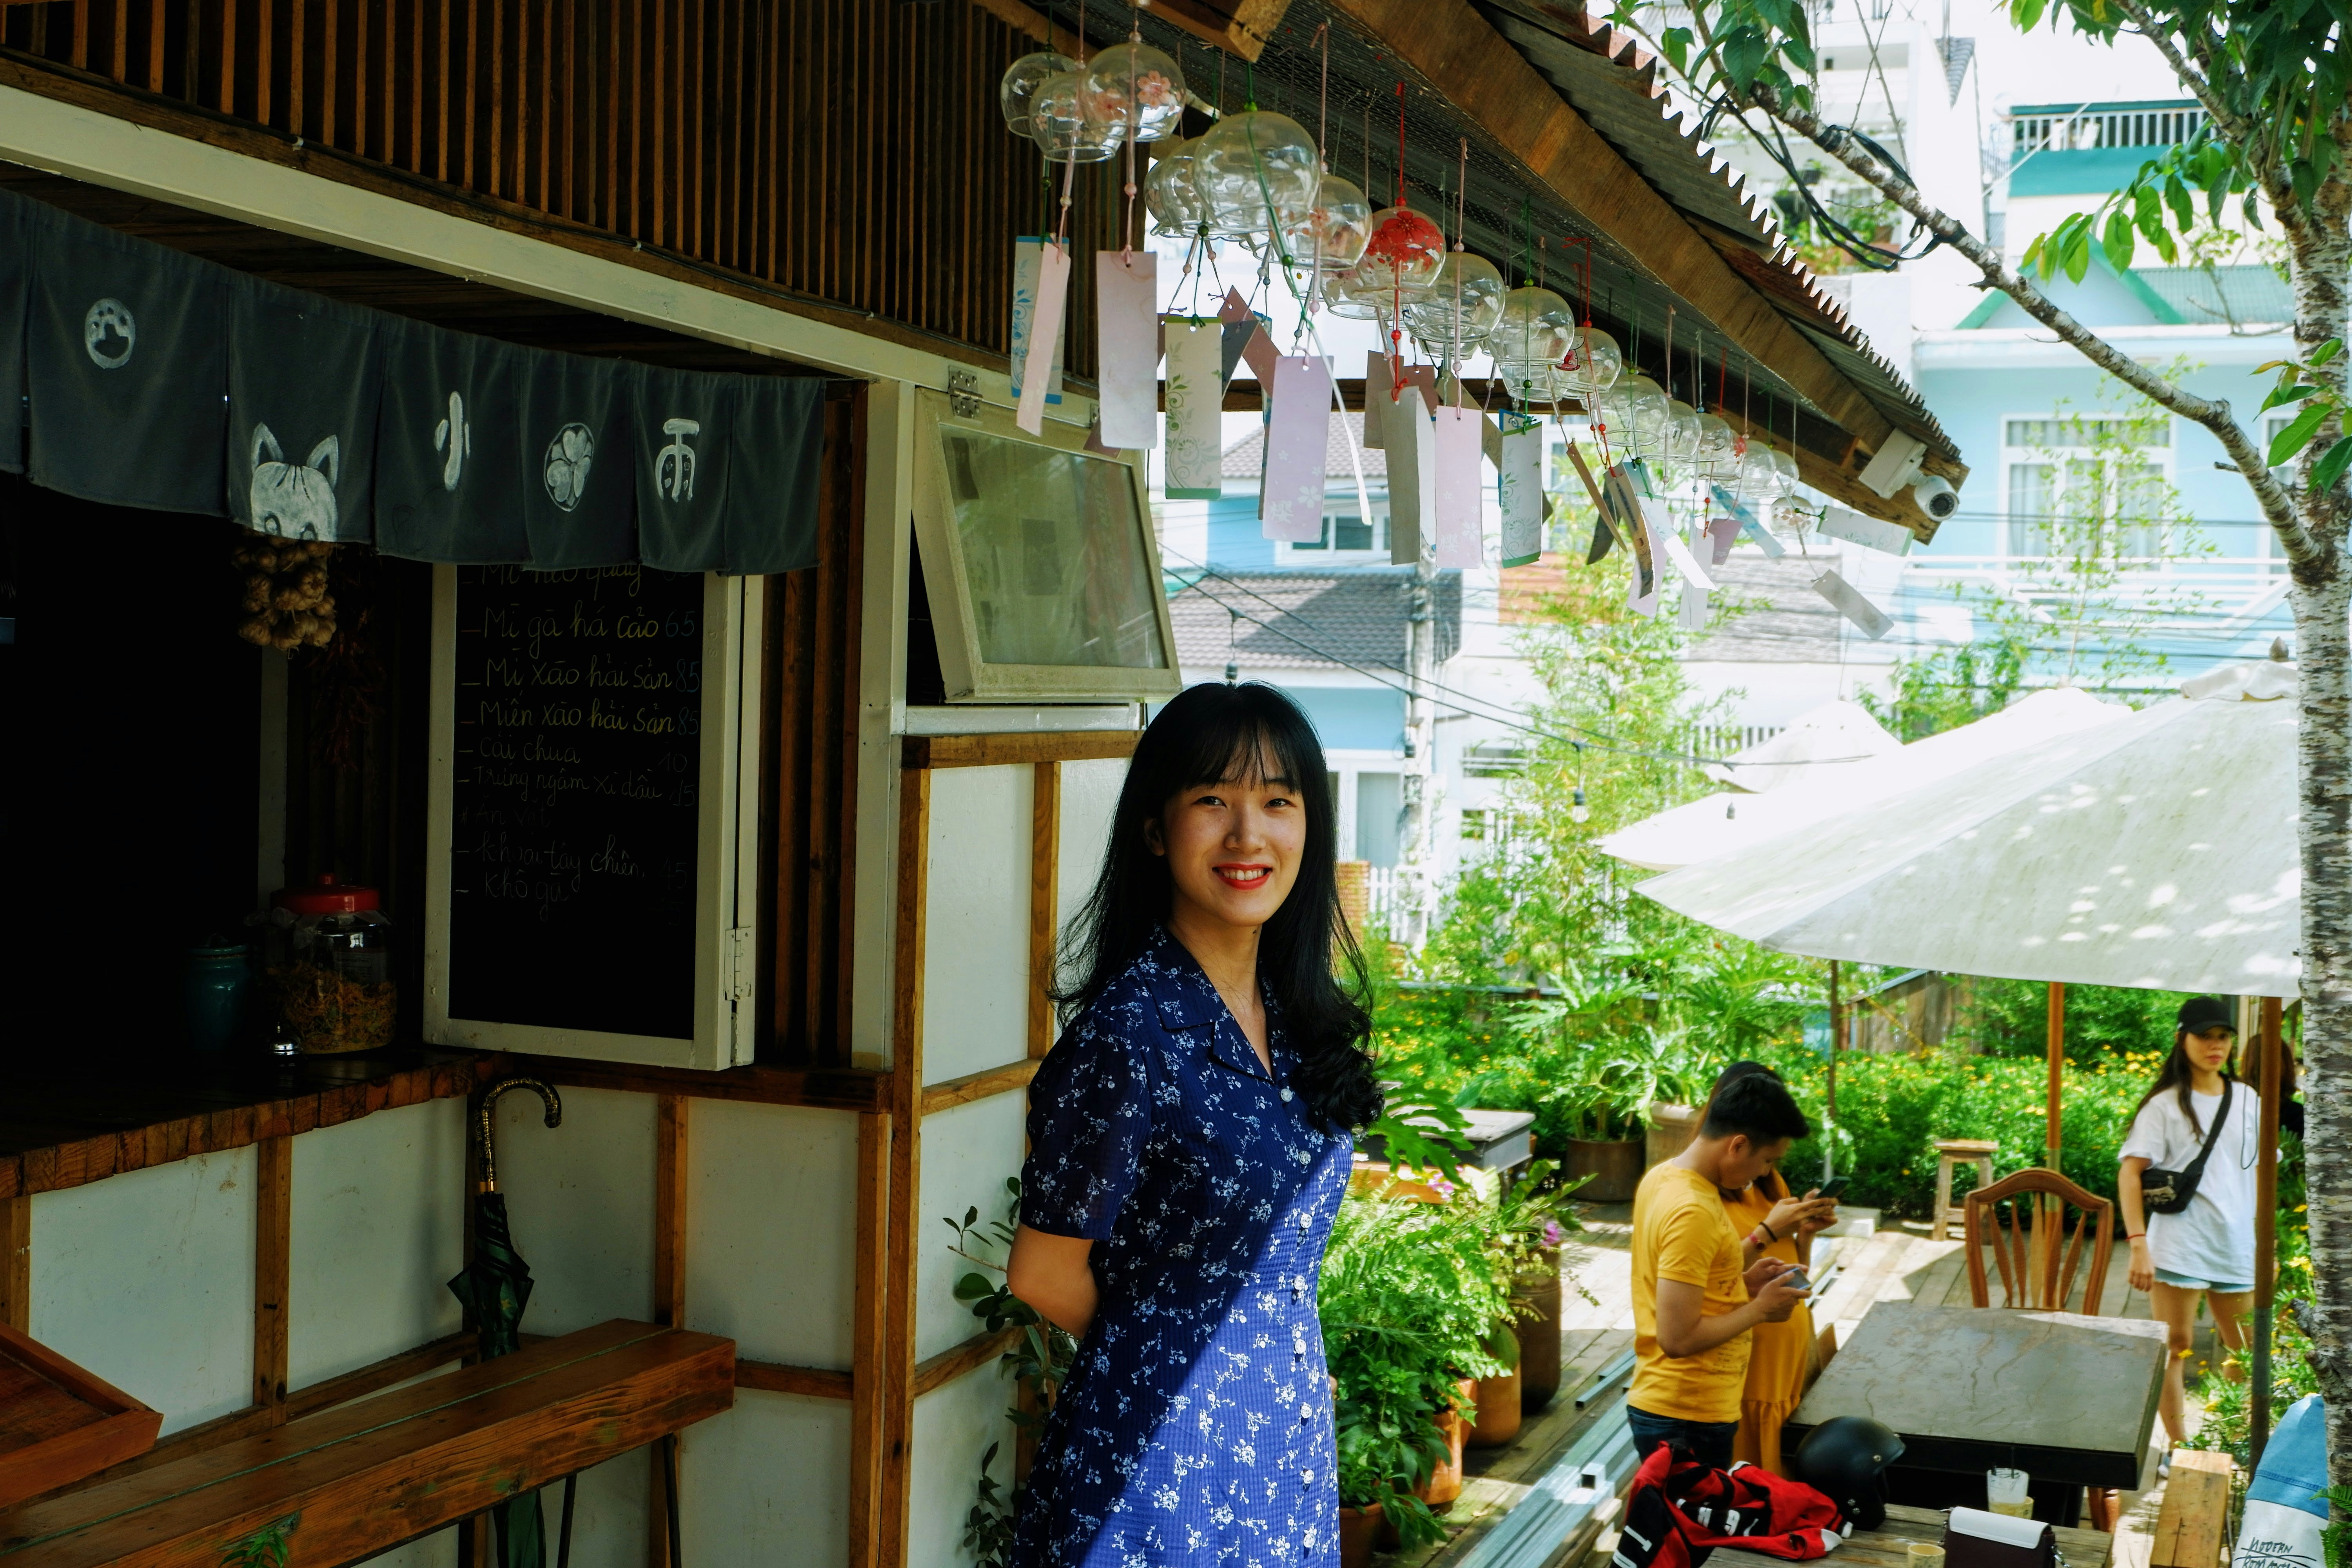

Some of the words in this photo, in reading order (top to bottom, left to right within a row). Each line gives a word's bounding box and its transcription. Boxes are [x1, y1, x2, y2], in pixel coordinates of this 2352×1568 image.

[666, 610, 696, 637] 65
[675, 658, 701, 693] 85
[677, 706, 699, 735] 85
